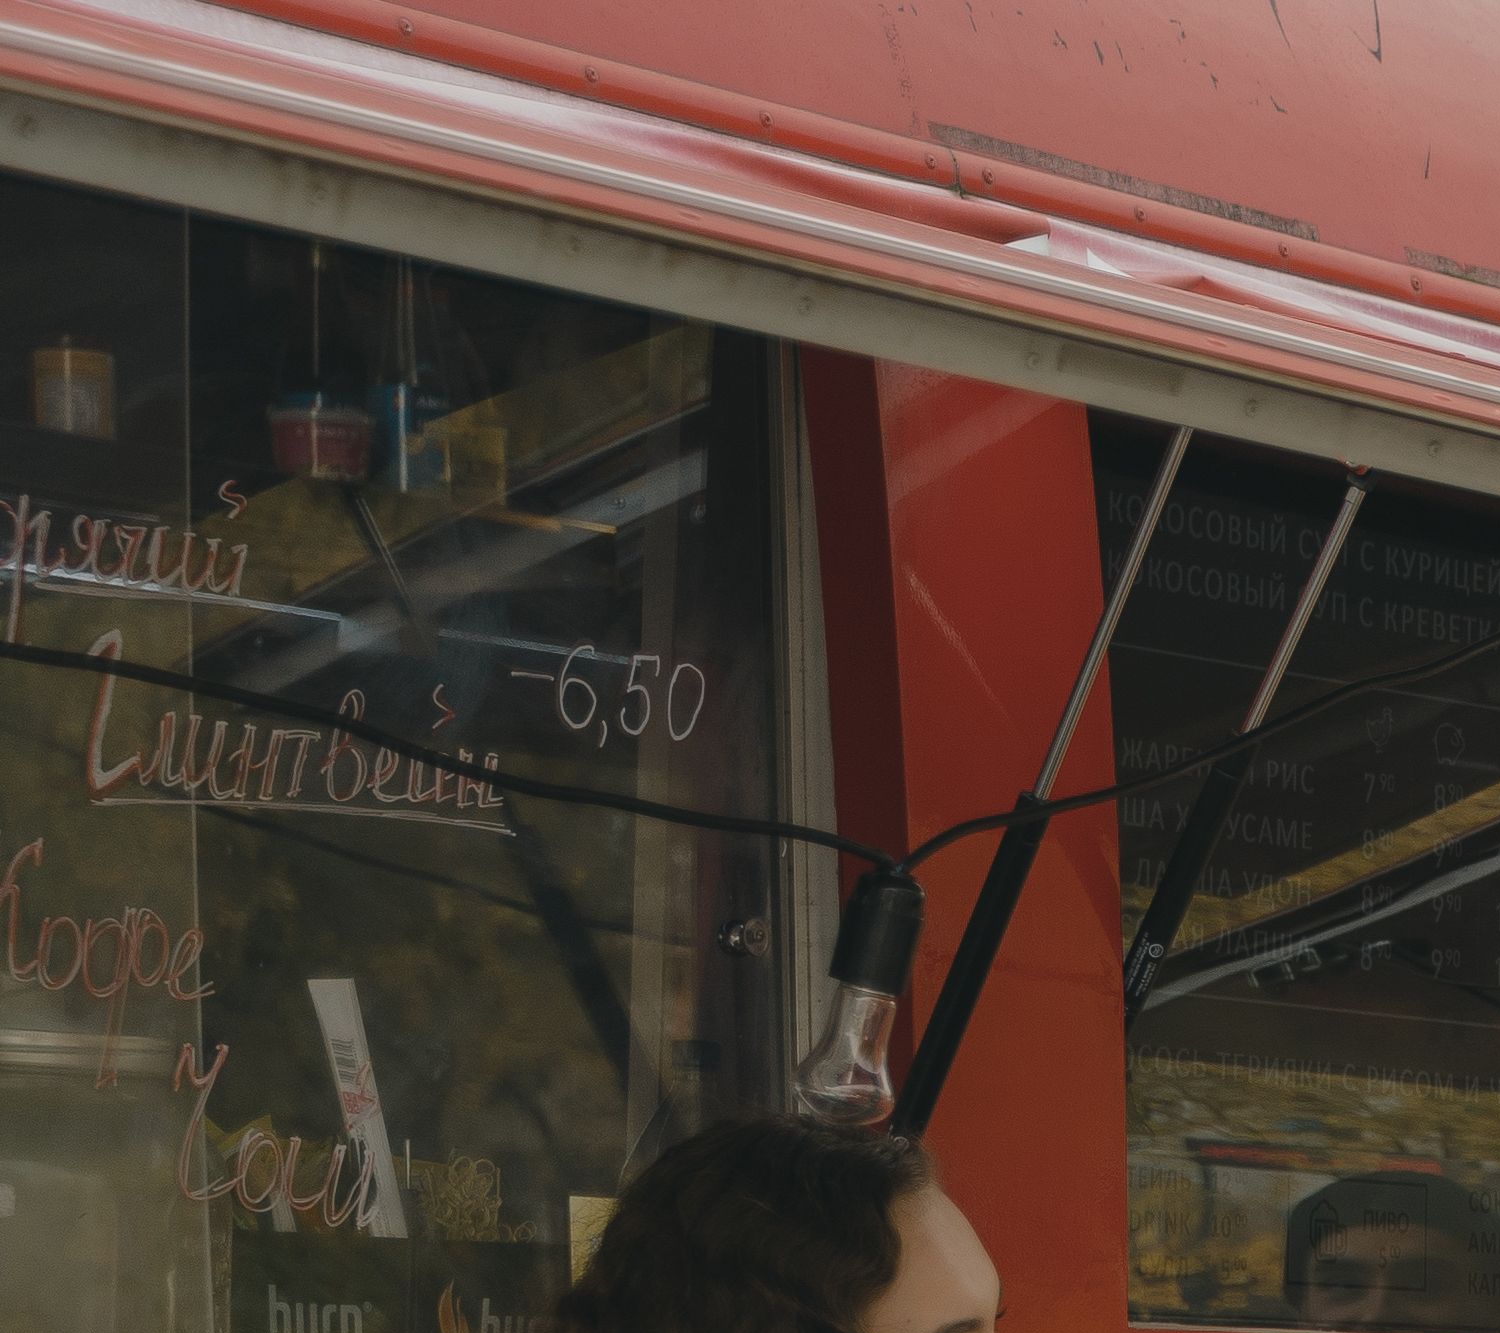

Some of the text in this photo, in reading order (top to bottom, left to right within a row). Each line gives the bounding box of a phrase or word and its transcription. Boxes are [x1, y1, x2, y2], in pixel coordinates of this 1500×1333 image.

[1109, 489, 1287, 554] КООСОВЫЙ
[1298, 585, 1347, 624] УП
[1266, 758, 1316, 795] РИС
[1175, 801, 1313, 850] ХУСАМЕ
[1136, 856, 1233, 898] ЛАША
[1366, 1065, 1455, 1102] РИСОМ
[1363, 1208, 1410, 1233] ПИВО
